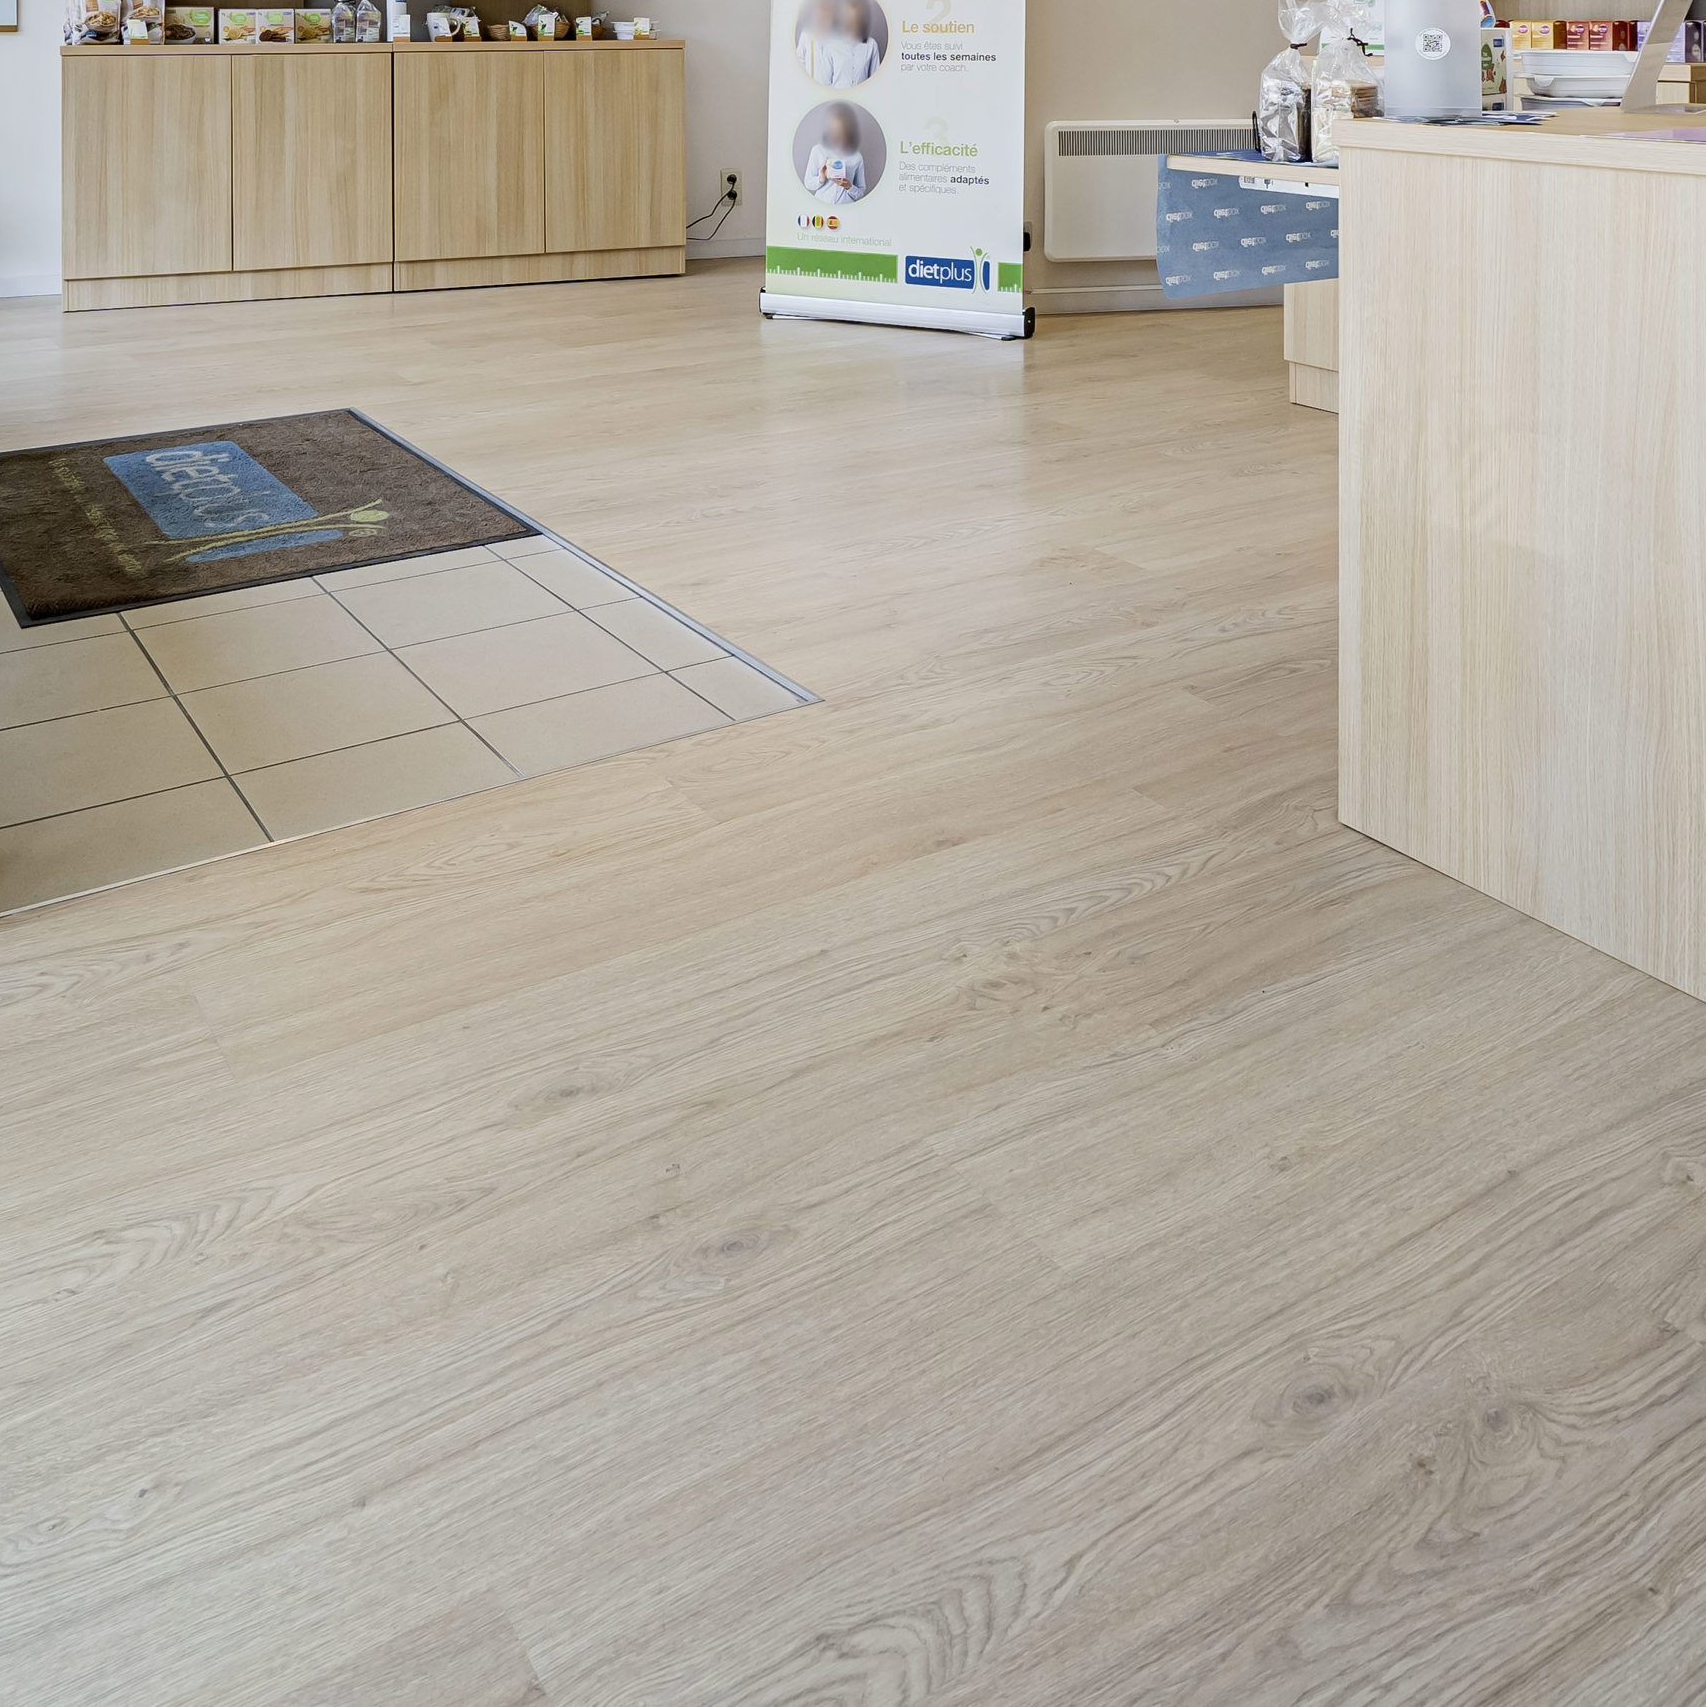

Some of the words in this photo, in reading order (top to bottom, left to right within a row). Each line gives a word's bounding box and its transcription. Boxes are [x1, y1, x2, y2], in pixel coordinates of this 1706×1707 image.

[902, 20, 919, 33] Le
[922, 20, 974, 33] soutien
[901, 52, 931, 60] toutes
[933, 52, 947, 60] les
[950, 52, 996, 61] semaines
[900, 141, 978, 157] L'efficacité
[950, 175, 989, 185] adaptés
[797, 232, 810, 242] Un
[841, 236, 893, 248] international
[907, 259, 973, 285] dietplus
